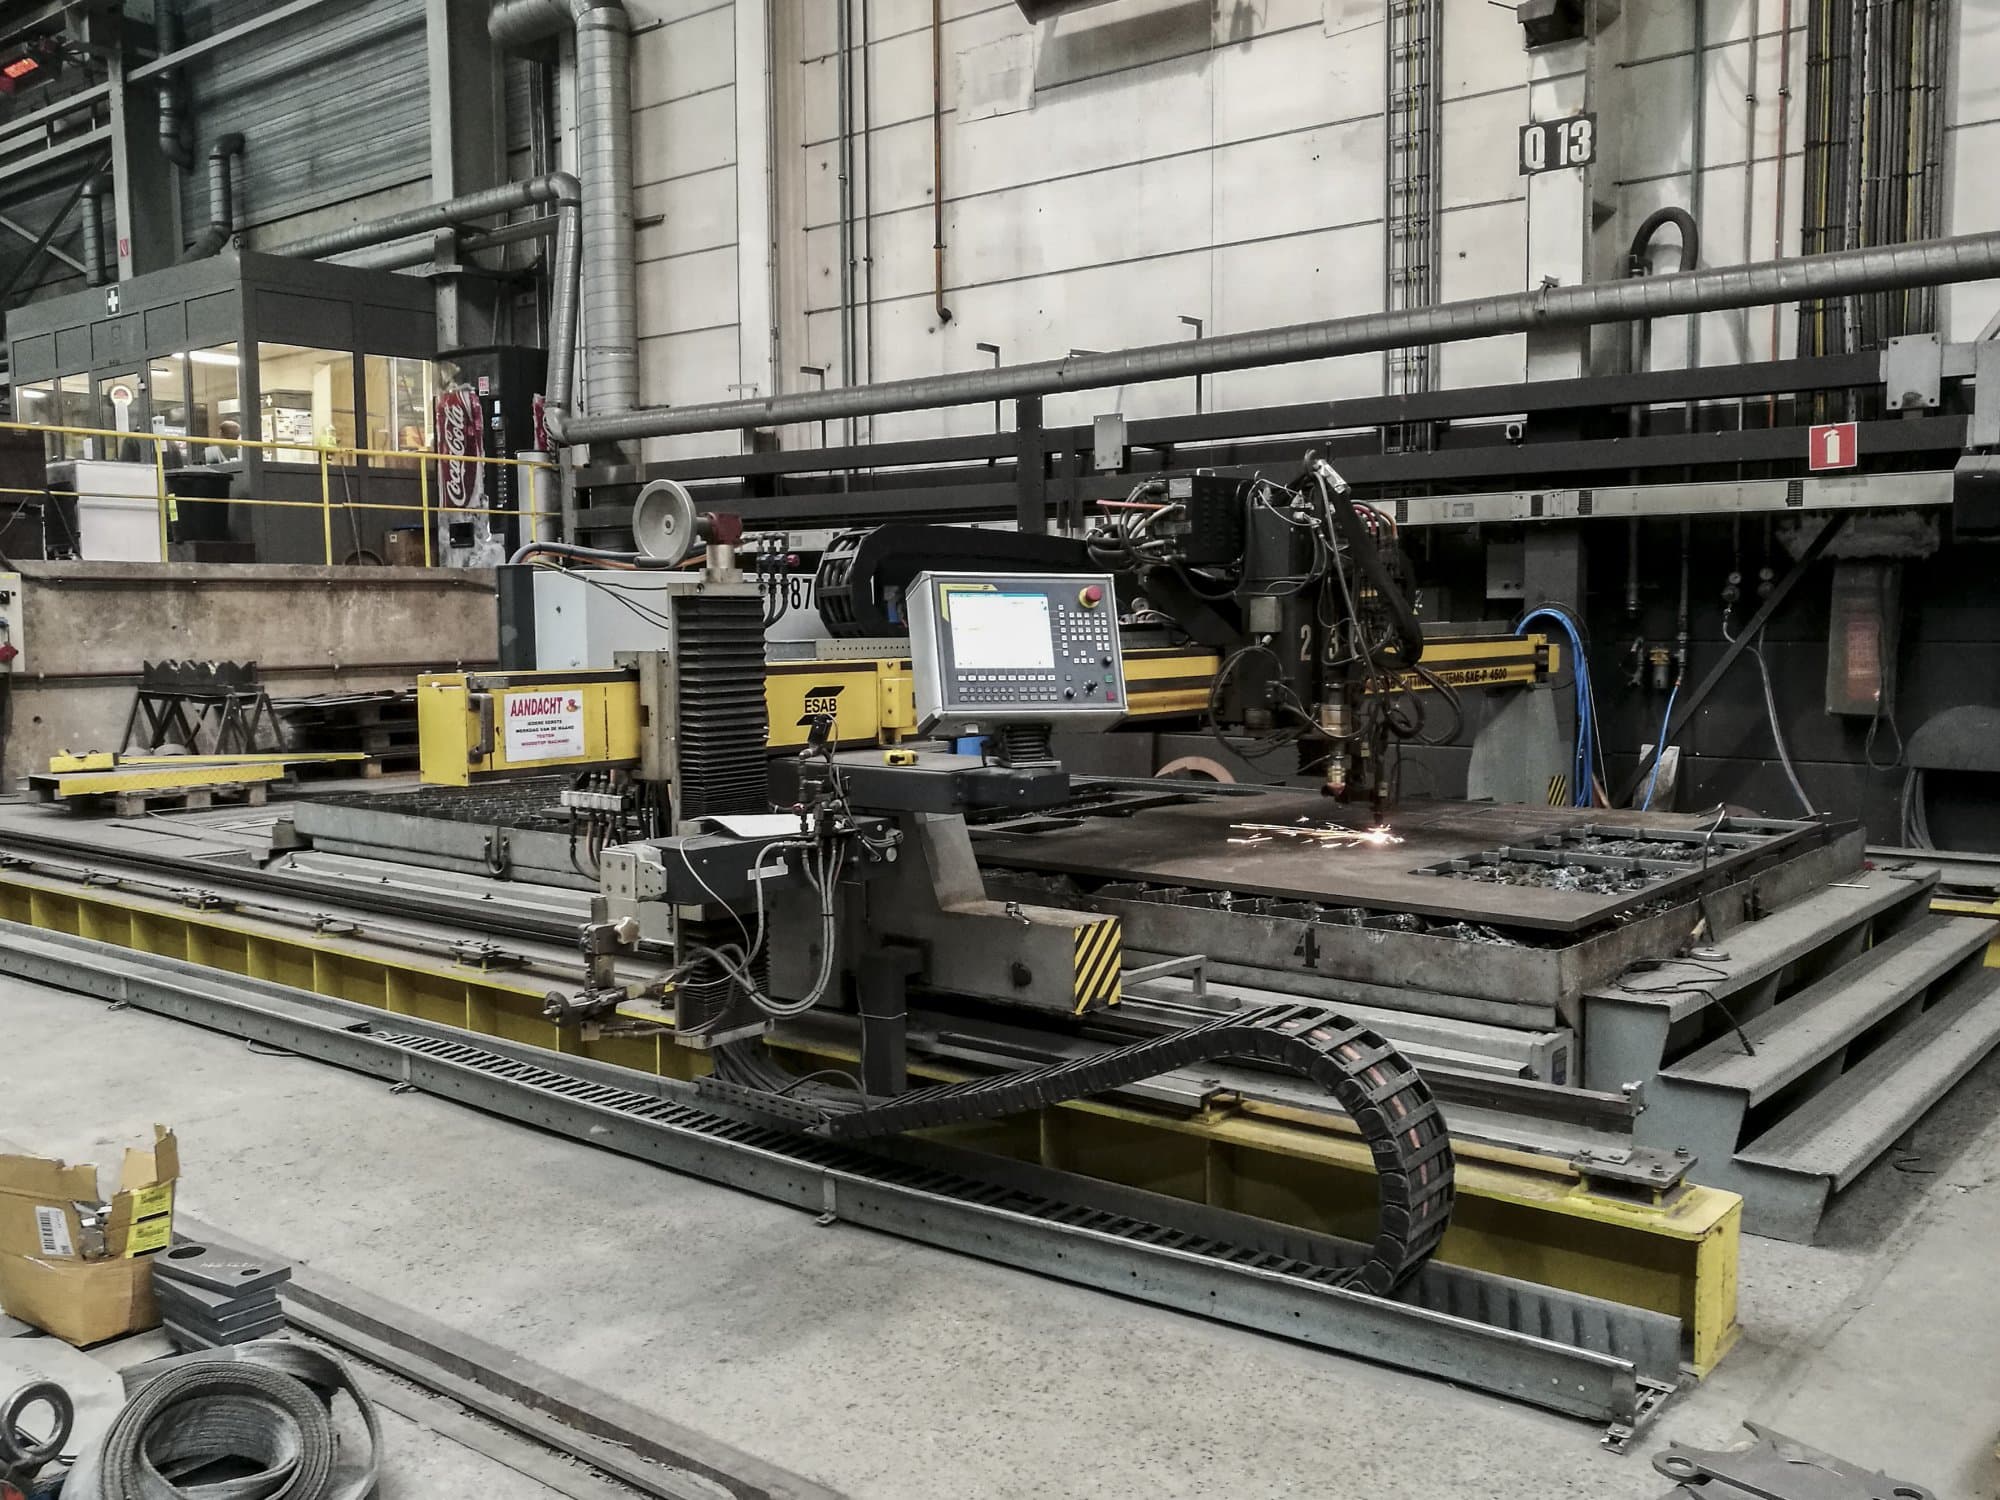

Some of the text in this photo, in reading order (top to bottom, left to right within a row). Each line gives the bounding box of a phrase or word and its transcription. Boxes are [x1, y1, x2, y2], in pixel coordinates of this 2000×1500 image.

[1524, 119, 1592, 169] Q 13
[1300, 624, 1311, 661] 2
[1489, 668, 1508, 680] 4500
[510, 697, 563, 717] AANDACHT
[804, 698, 837, 713] ESAB
[1293, 928, 1320, 969] 4
